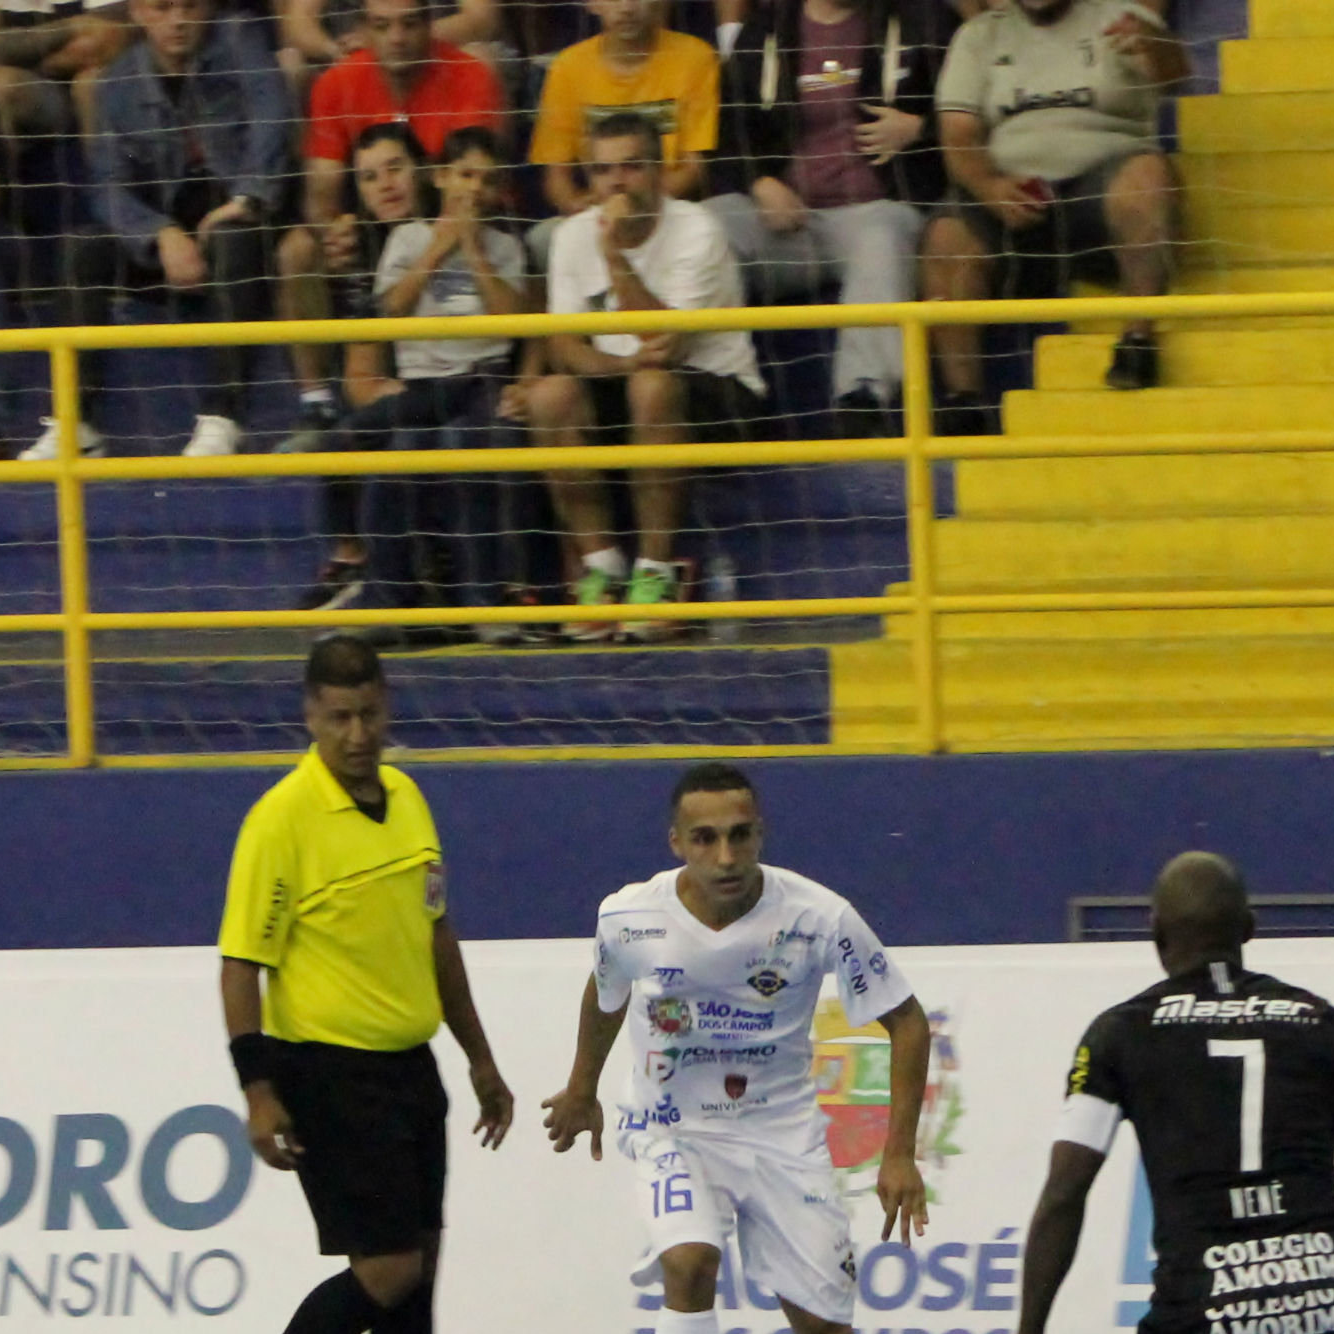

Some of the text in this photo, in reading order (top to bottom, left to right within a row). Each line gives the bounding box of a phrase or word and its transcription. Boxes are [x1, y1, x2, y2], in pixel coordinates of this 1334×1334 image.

[1153, 993, 1315, 1018] Master
[1207, 1038, 1264, 1172] 7
[651, 1173, 693, 1218] 16
[859, 1226, 1021, 1312] OSÉ
